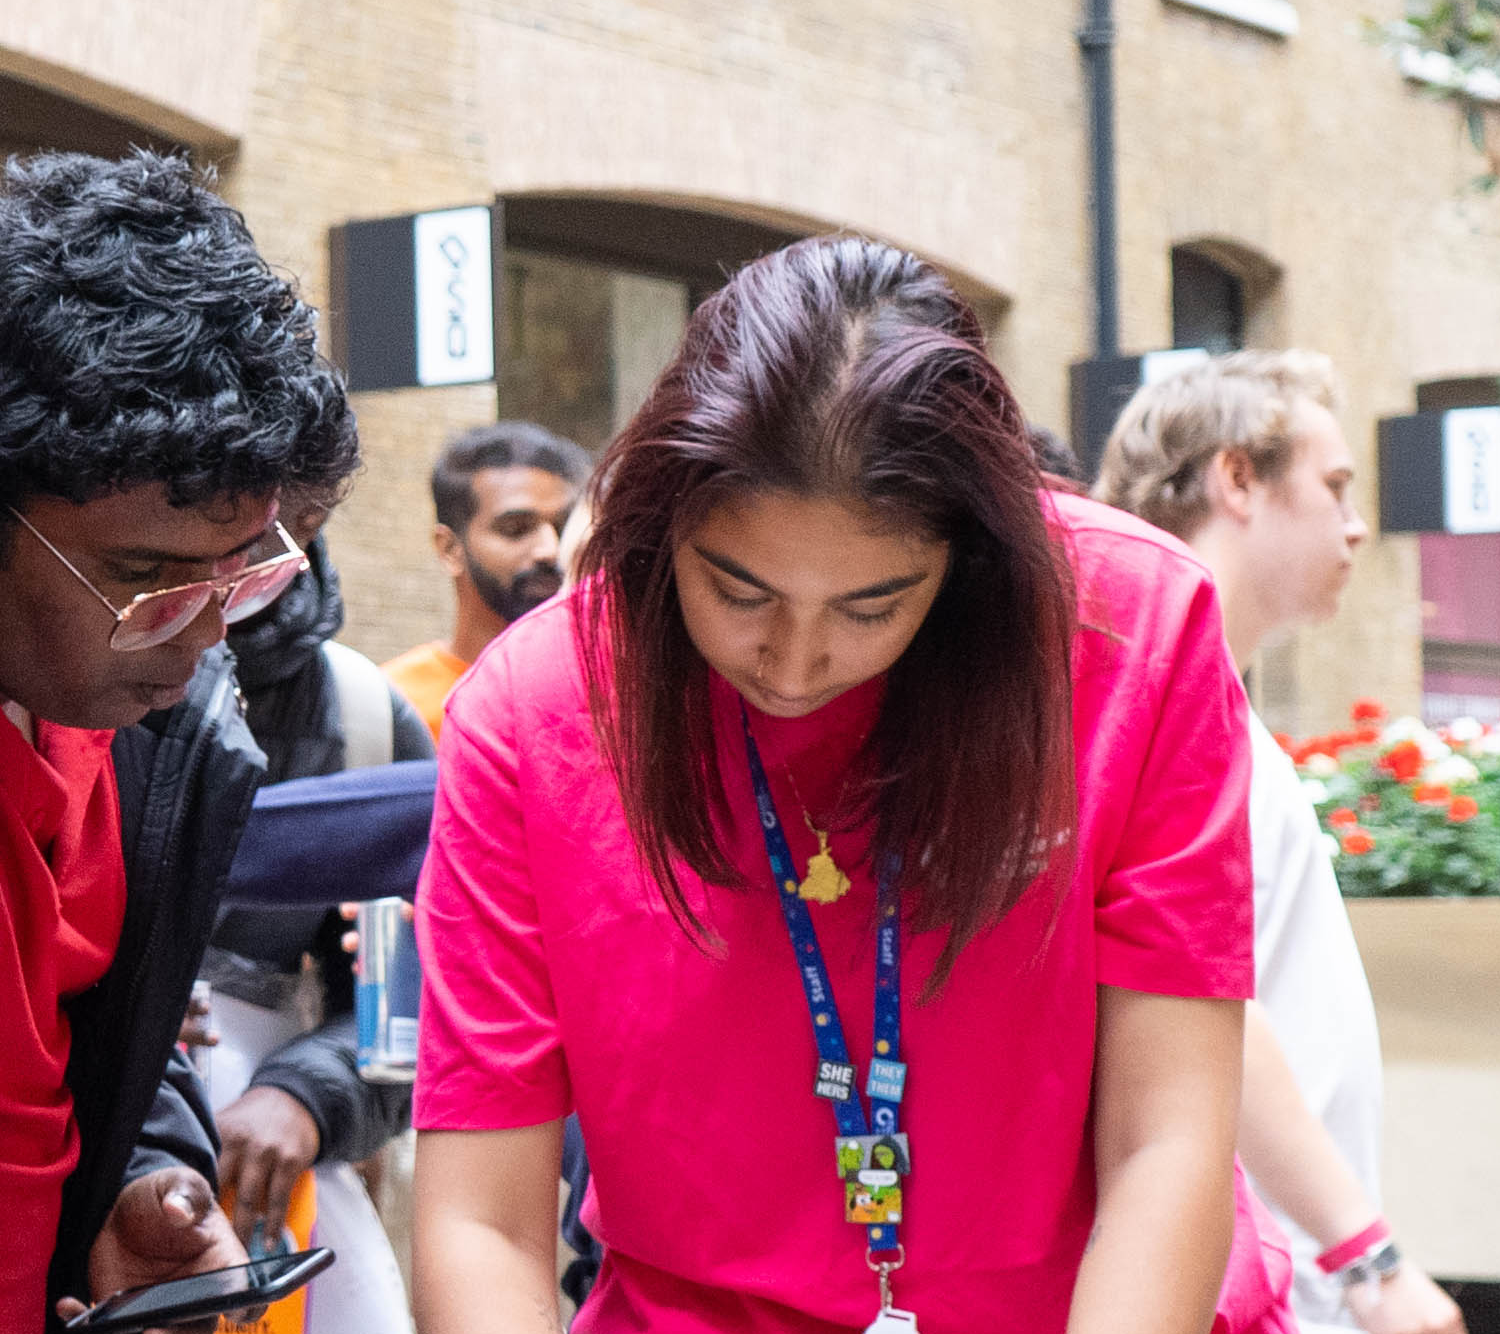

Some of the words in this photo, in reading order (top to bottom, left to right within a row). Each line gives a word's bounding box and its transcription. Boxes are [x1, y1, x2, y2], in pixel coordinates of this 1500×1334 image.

[820, 1062, 853, 1084] SHE
[874, 1063, 903, 1079] THEY
[816, 1081, 850, 1100] HERS
[871, 1080, 901, 1097] THEM
